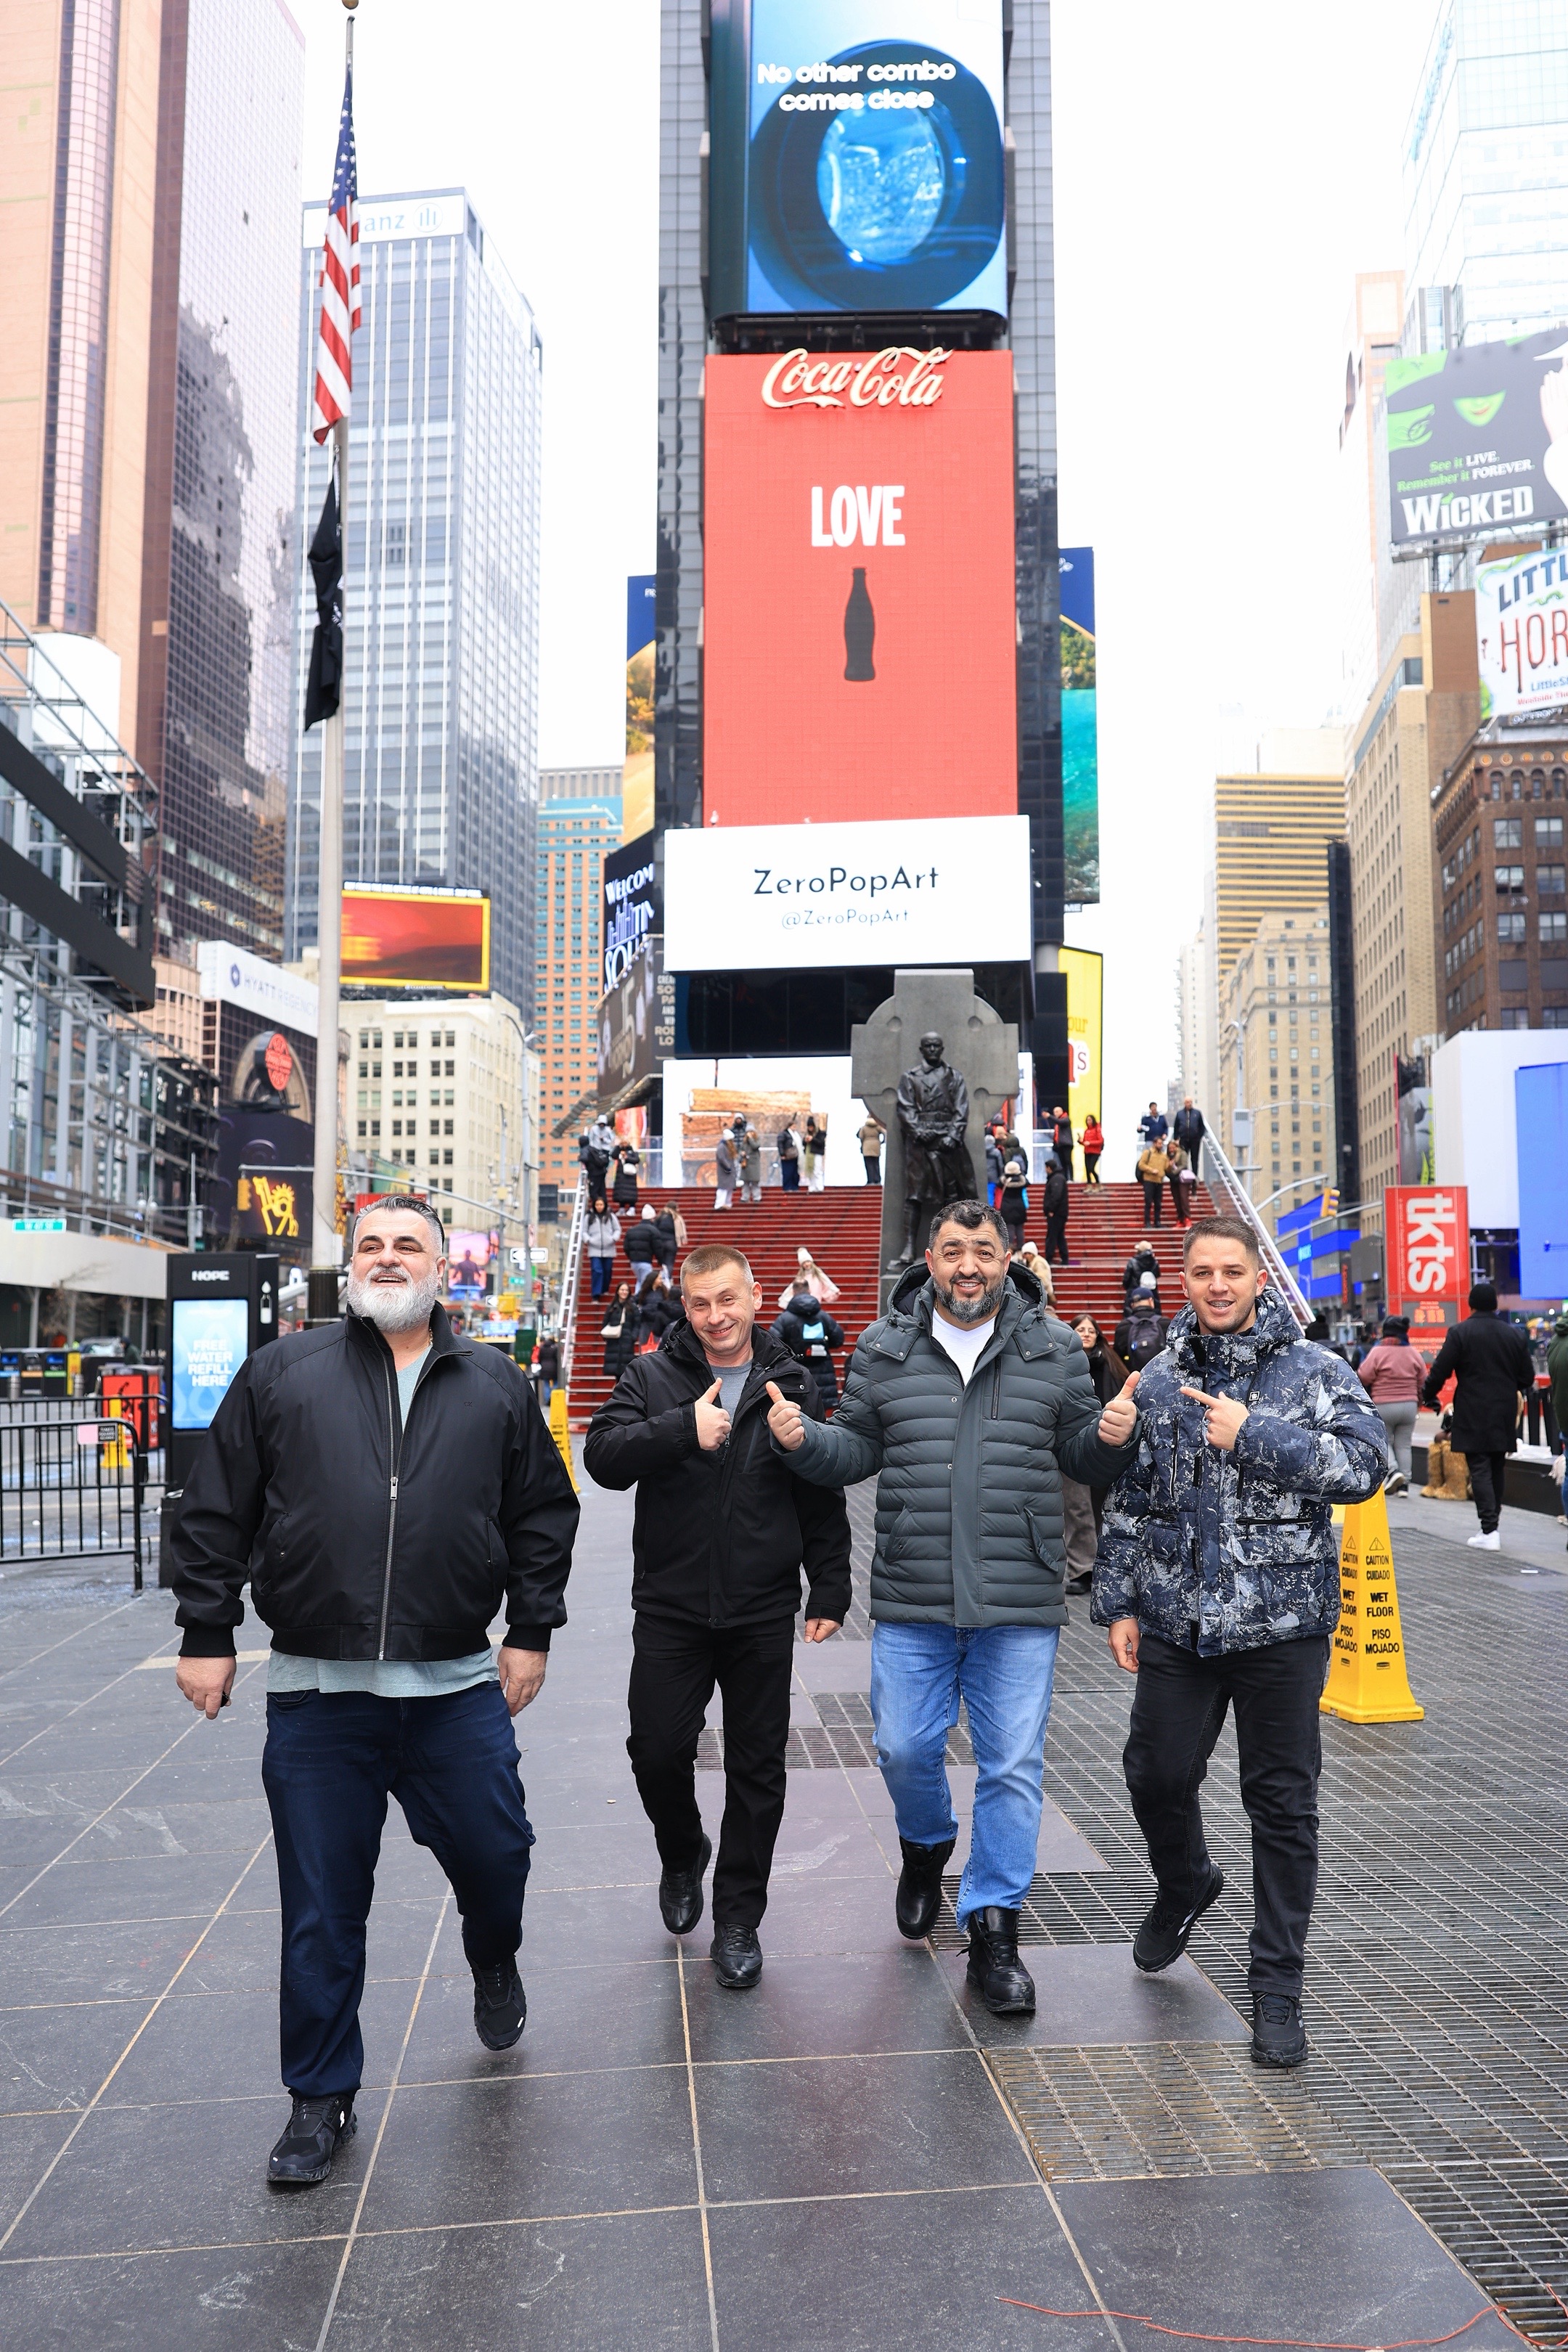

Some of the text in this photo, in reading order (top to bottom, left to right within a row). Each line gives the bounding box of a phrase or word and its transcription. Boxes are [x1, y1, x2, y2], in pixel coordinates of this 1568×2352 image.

[757, 60, 956, 83] No other combo
[779, 88, 935, 111] comes close
[1429, 450, 1500, 472] See it LIVE.
[1397, 459, 1535, 493] Remember it FOREVER.
[812, 485, 906, 547] LOVE
[754, 865, 939, 897] ZeroPopArt
[782, 909, 908, 930] @ZeroPopArt
[1406, 1193, 1456, 1294] tkts
[193, 1339, 227, 1352] FREE
[187, 1351, 233, 1363] WATER
[187, 1363, 233, 1375] REFILL
[192, 1374, 229, 1387] HERE
[1342, 1552, 1358, 1565] CAUTION
[1365, 1555, 1389, 1565] CAUTION
[1342, 1567, 1357, 1580] CUIDADO
[1366, 1570, 1390, 1580] CUIDADO
[1342, 1588, 1355, 1601] WET
[1370, 1592, 1389, 1603] WET
[1366, 1606, 1394, 1617] FLOOR
[1340, 1624, 1354, 1638] PISO
[1372, 1628, 1391, 1640] PISO
[1334, 1637, 1358, 1653] MOJADO
[1365, 1642, 1400, 1654] MOJADO
